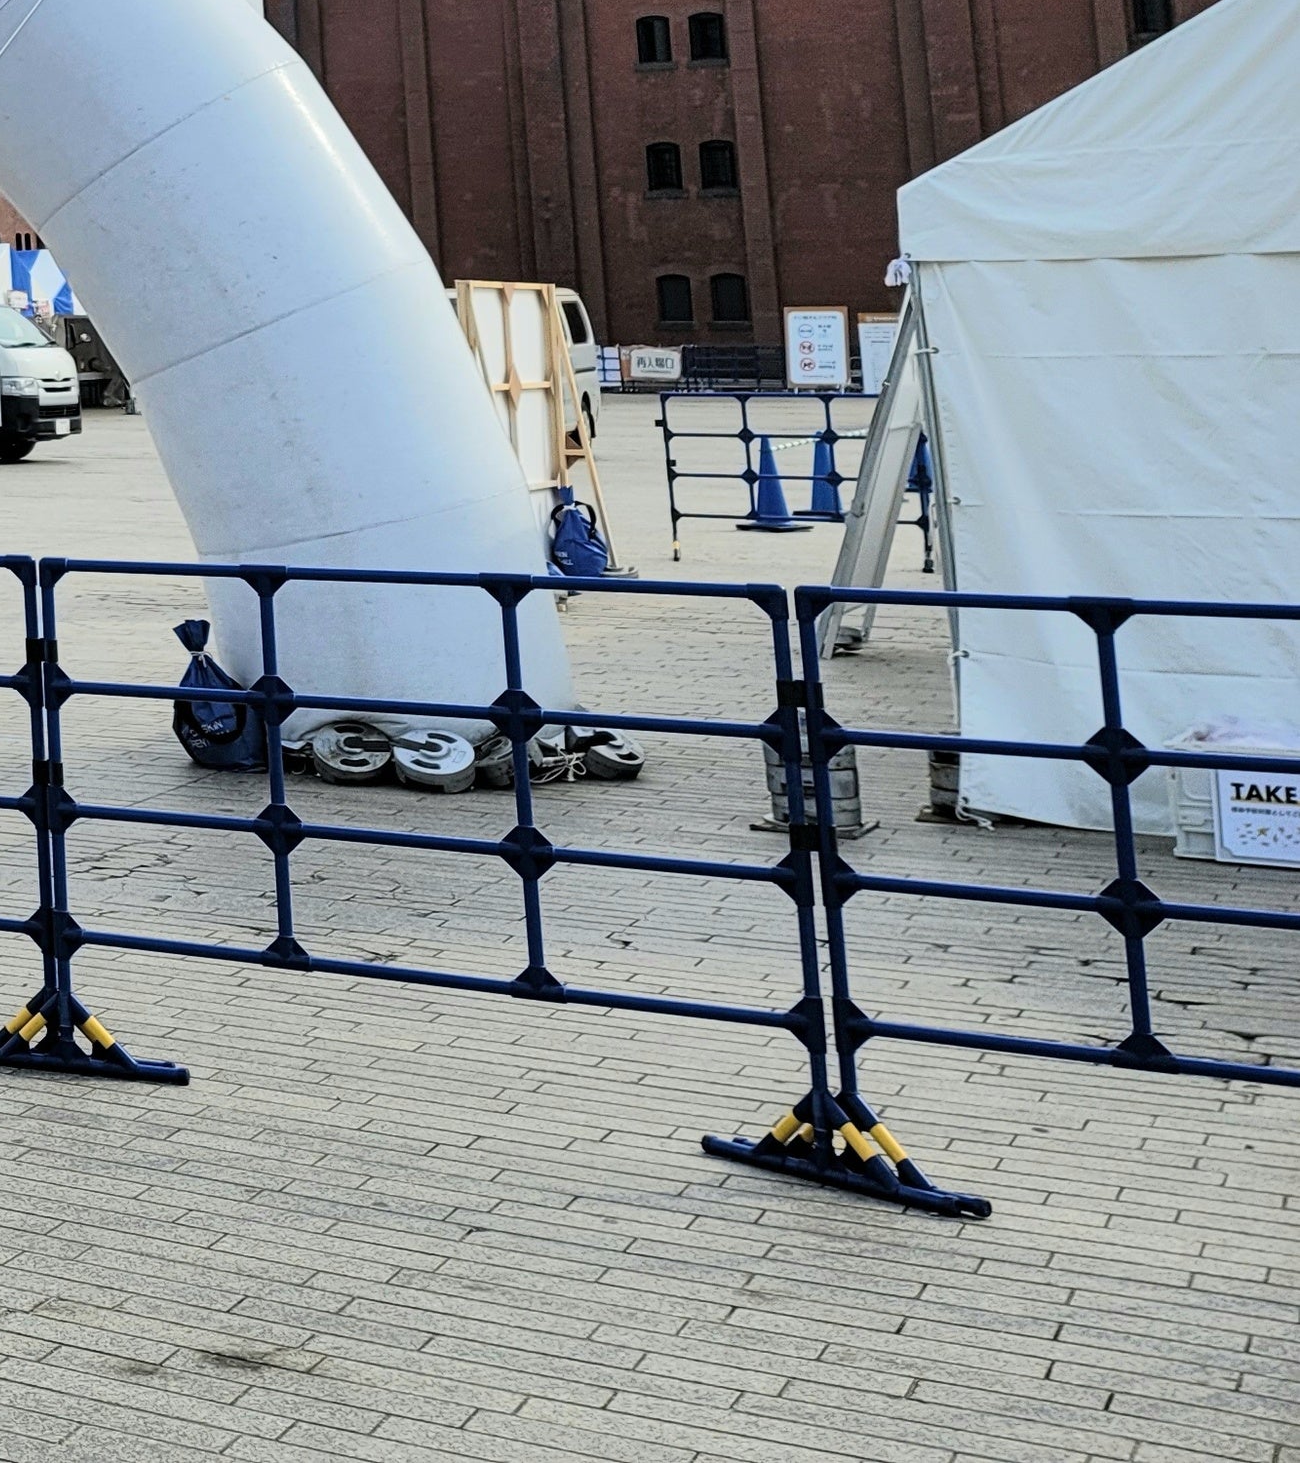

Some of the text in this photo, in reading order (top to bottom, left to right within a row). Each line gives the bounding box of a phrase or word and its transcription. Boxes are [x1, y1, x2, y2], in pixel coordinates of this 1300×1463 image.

[636, 356, 675, 369] 再入場口
[1230, 782, 1298, 804] TAKE
